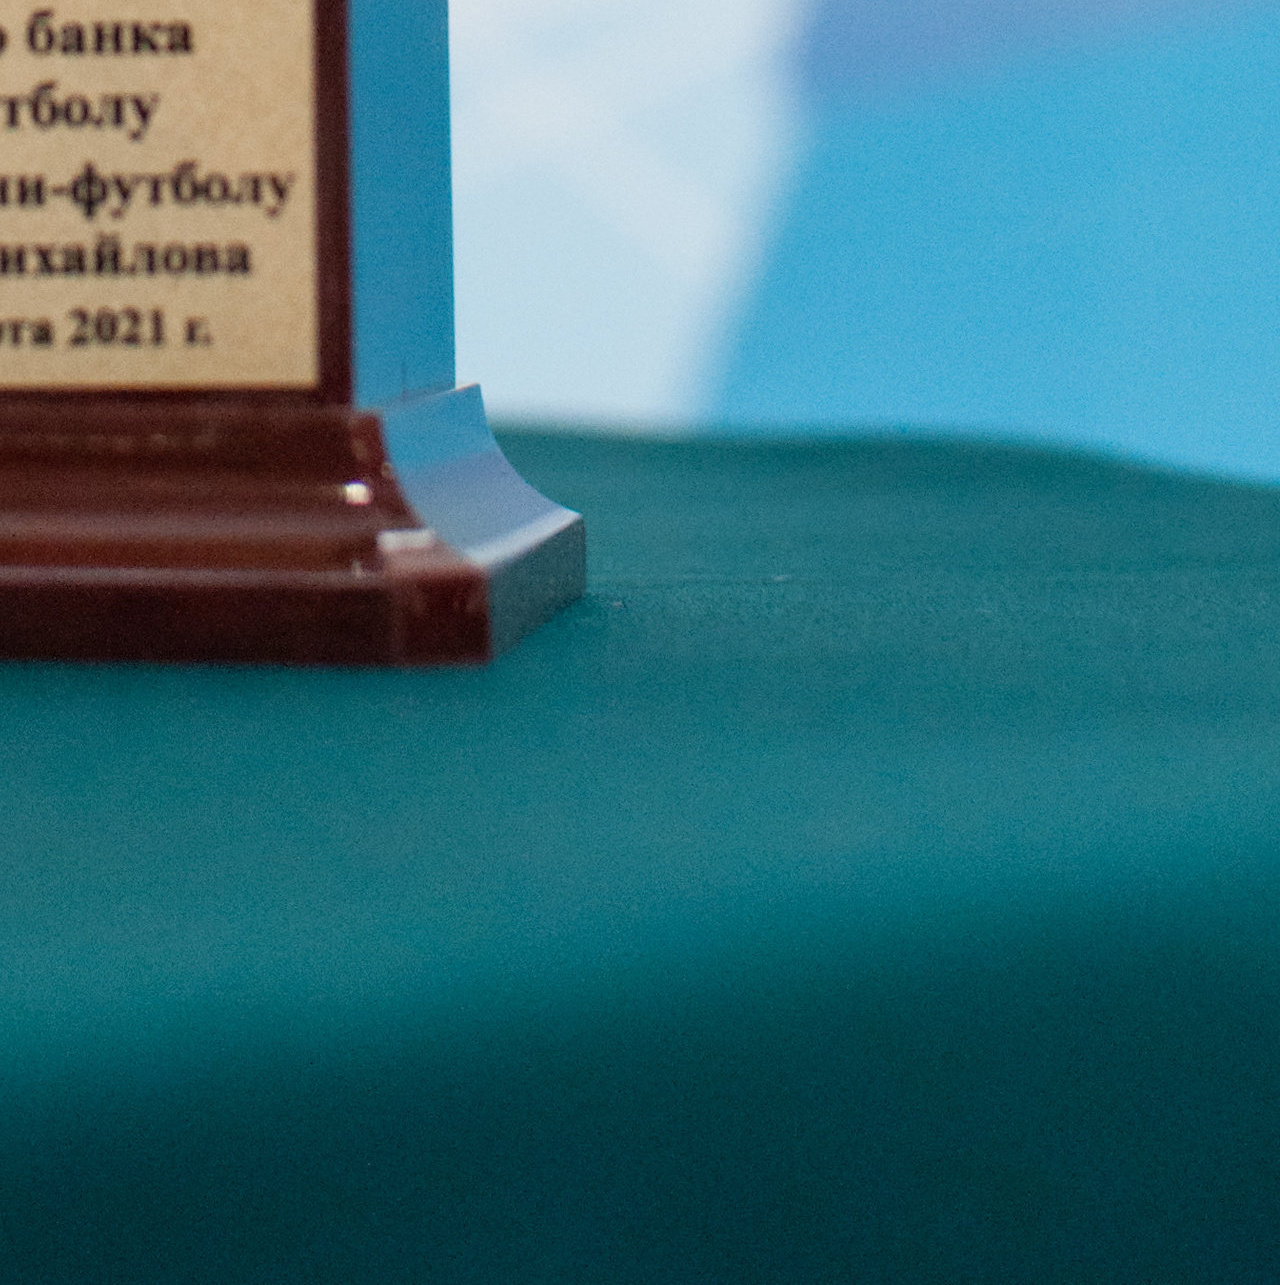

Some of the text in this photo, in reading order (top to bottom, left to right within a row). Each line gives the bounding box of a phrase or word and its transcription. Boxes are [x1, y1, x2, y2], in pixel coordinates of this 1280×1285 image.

[26, 9, 194, 56] банка
[69, 307, 165, 348] 2021
[184, 318, 212, 347] г.
